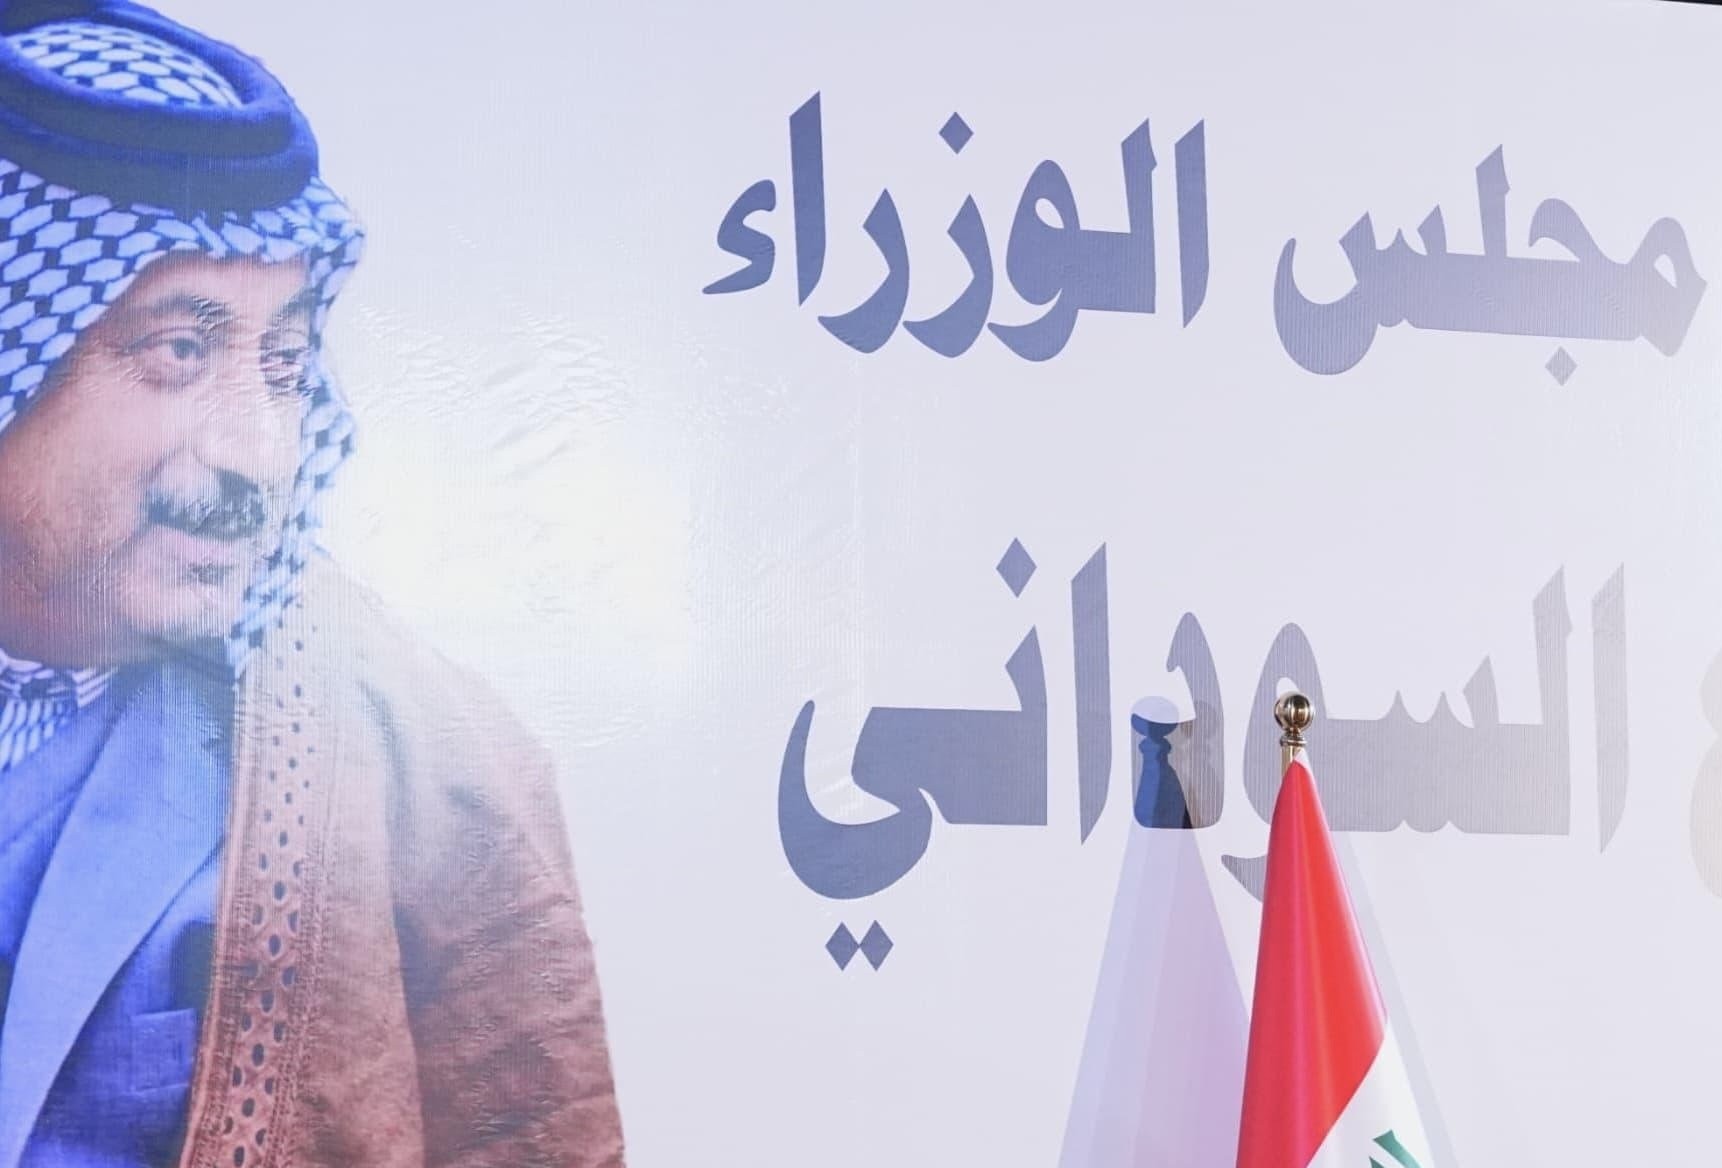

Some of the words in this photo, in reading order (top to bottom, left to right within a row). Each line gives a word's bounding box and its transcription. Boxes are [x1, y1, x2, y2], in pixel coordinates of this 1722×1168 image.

[702, 90, 1209, 362] الوزراء
[1273, 143, 1708, 388] مجلس
[778, 537, 1630, 972] السوداني
